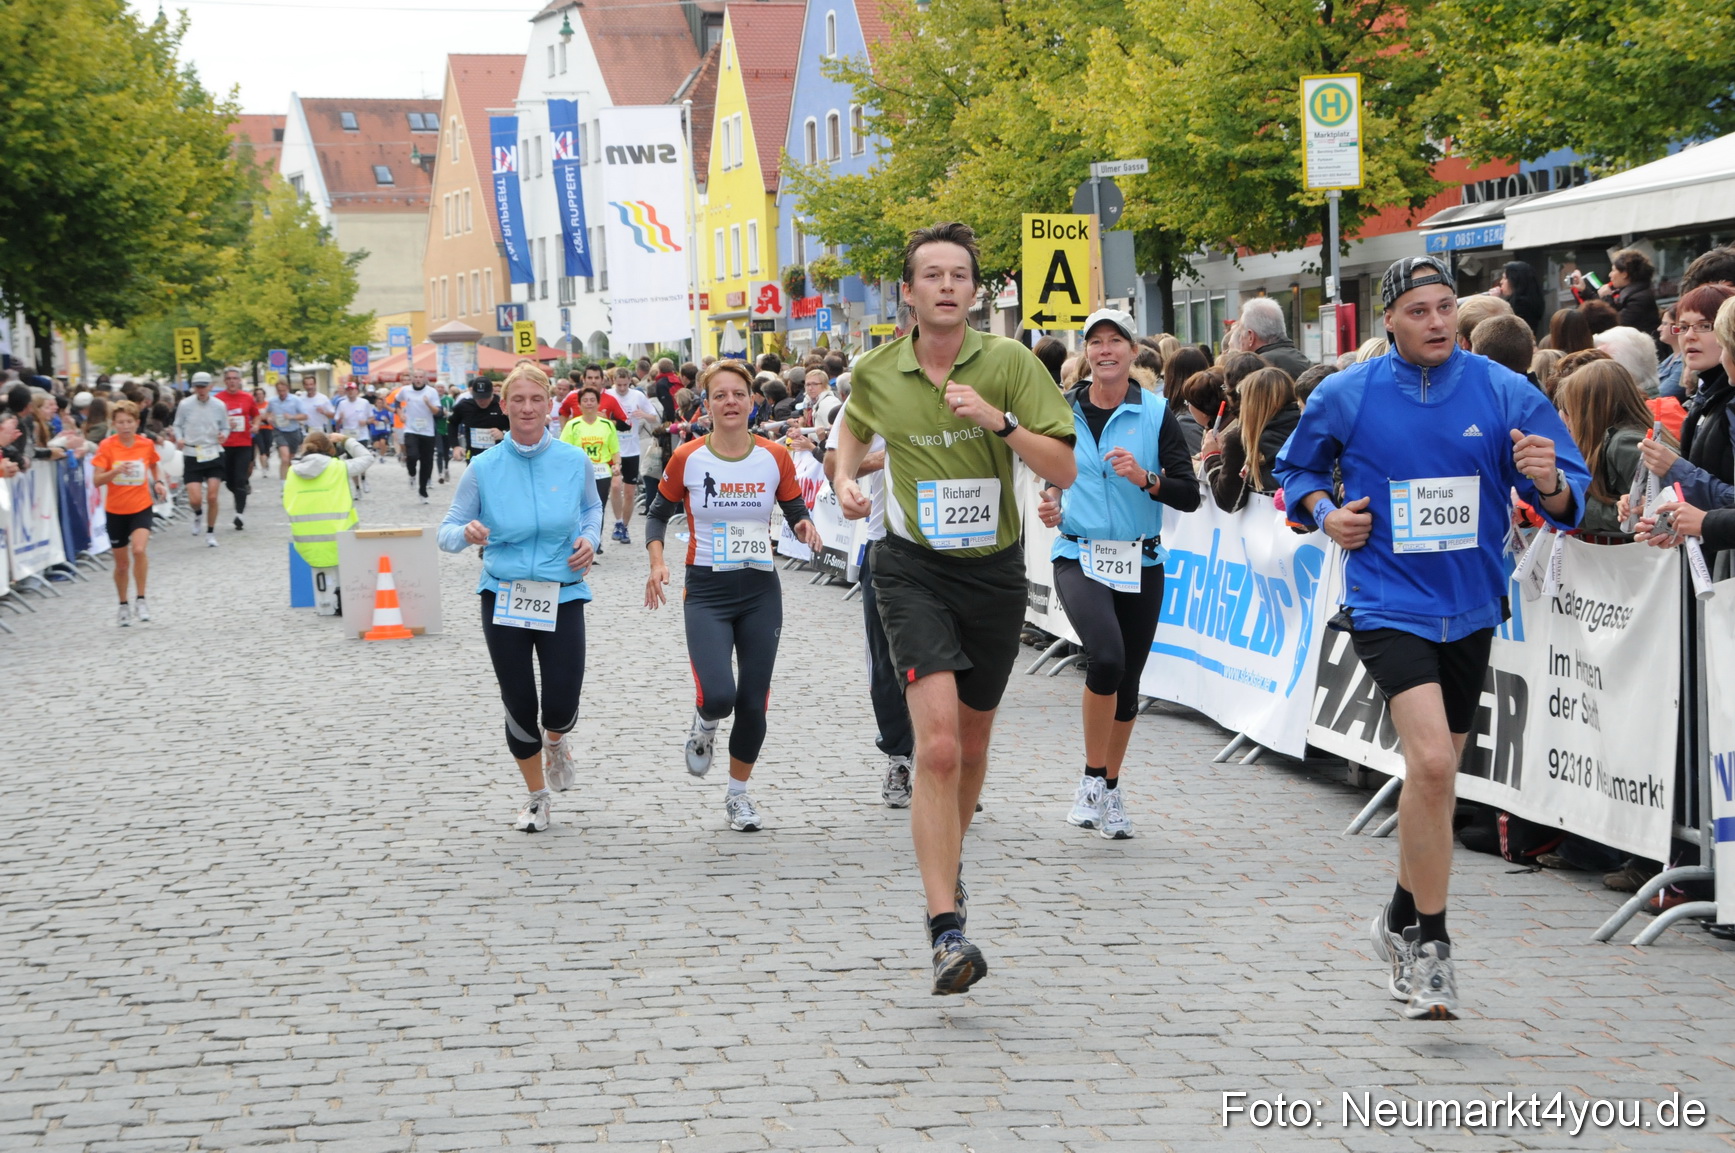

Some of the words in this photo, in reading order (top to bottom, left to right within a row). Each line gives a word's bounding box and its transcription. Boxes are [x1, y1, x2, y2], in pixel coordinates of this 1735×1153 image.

[1321, 93, 1342, 117] H
[1314, 131, 1350, 140] Marktplatz
[1101, 164, 1121, 173] Ulmer
[1123, 163, 1144, 172] Gasse
[1461, 170, 1546, 205] ANTON
[1554, 165, 1585, 191] PE
[565, 165, 580, 227] RUPPERT
[1031, 218, 1089, 240] Block
[571, 229, 585, 253] K&L
[1455, 232, 1475, 246] OBST
[1038, 249, 1081, 305] A
[819, 310, 829, 329] P
[182, 338, 194, 355] B
[520, 331, 532, 347] B
[909, 434, 943, 447] EURO
[952, 426, 984, 442] POLES
[586, 447, 598, 456] M
[717, 490, 758, 499] Reisen
[720, 482, 766, 493] MERZ
[942, 486, 981, 499] Richard
[1417, 486, 1454, 500] Marius
[944, 505, 991, 525] 2224
[1398, 508, 1404, 517] C
[1419, 505, 1470, 526] 2608
[730, 526, 744, 537] Sigi
[969, 535, 995, 543] PFLEIDERER
[717, 540, 722, 548] C
[731, 540, 767, 554] 2789
[1095, 544, 1117, 555] Petra
[1447, 537, 1476, 546] PFLEIDERER
[1096, 559, 1132, 575] 2781
[515, 583, 527, 593] Pia
[1157, 527, 1293, 657] ackstar
[513, 597, 551, 613] 2782
[1549, 644, 1570, 678] Im
[1549, 687, 1578, 721] der
[1548, 748, 1593, 788] 92318
[1596, 759, 1664, 810] Neumarkt
